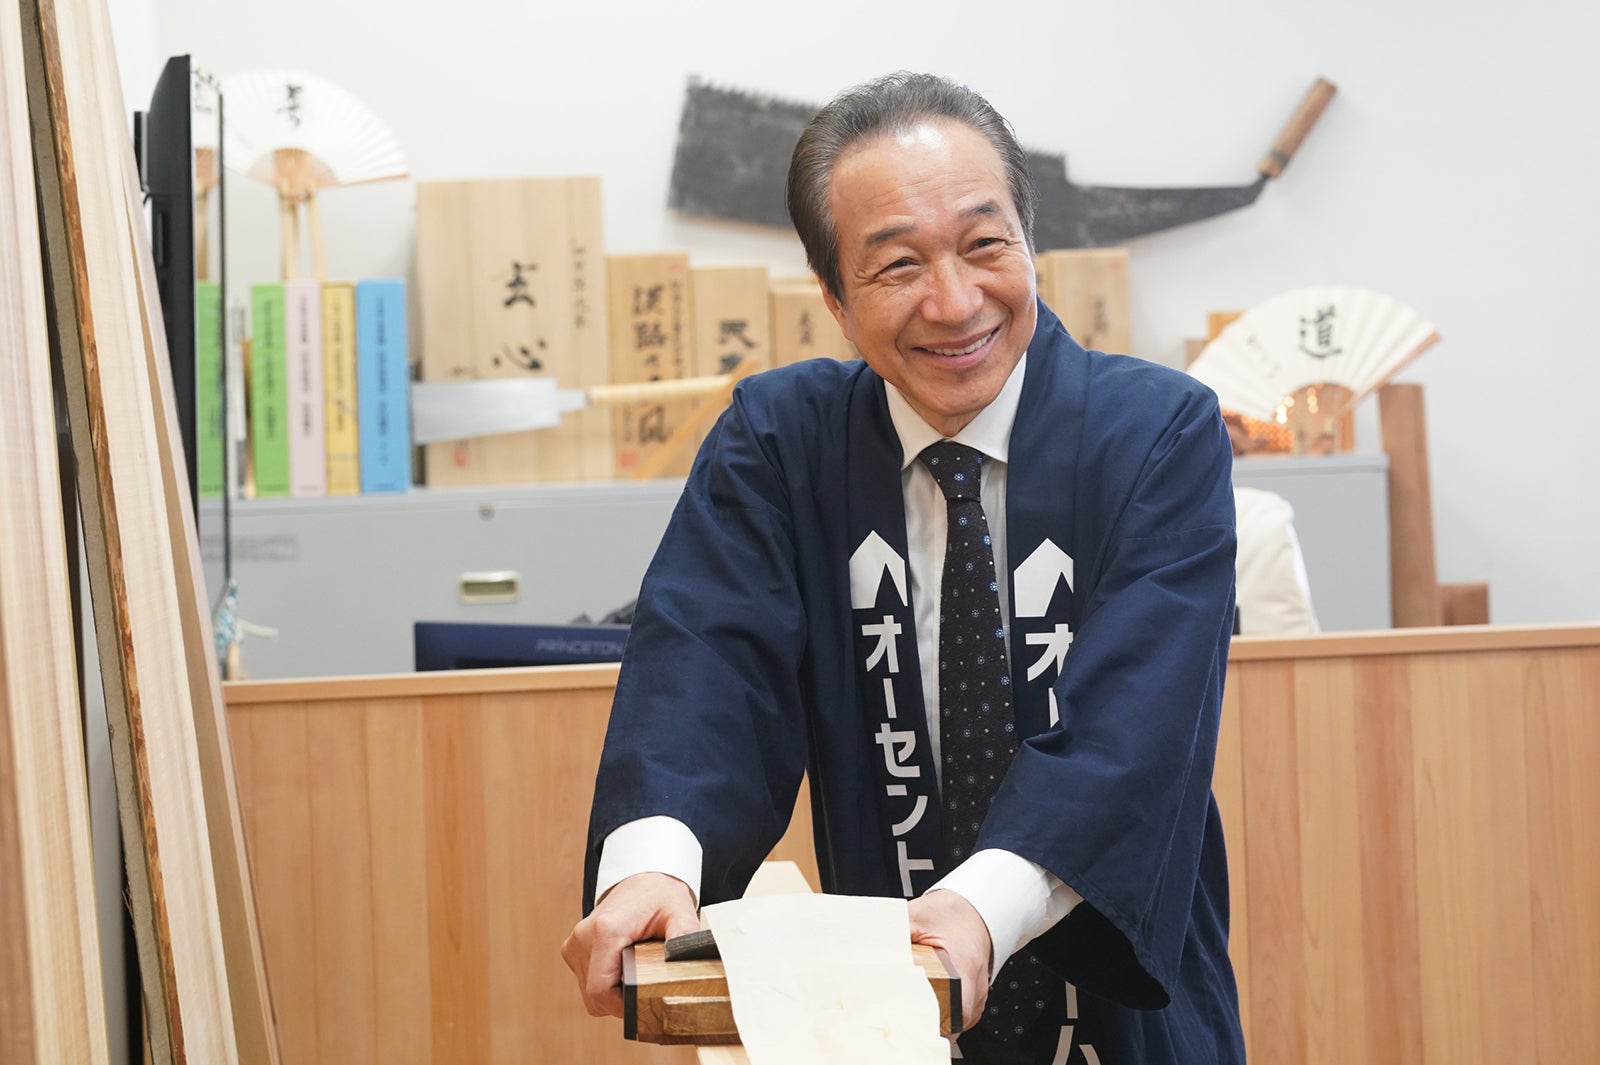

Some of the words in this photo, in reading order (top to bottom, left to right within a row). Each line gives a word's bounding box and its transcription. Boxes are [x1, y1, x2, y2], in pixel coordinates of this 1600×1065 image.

[1298, 303, 1343, 361] 道
[860, 614, 935, 898] オーセント
